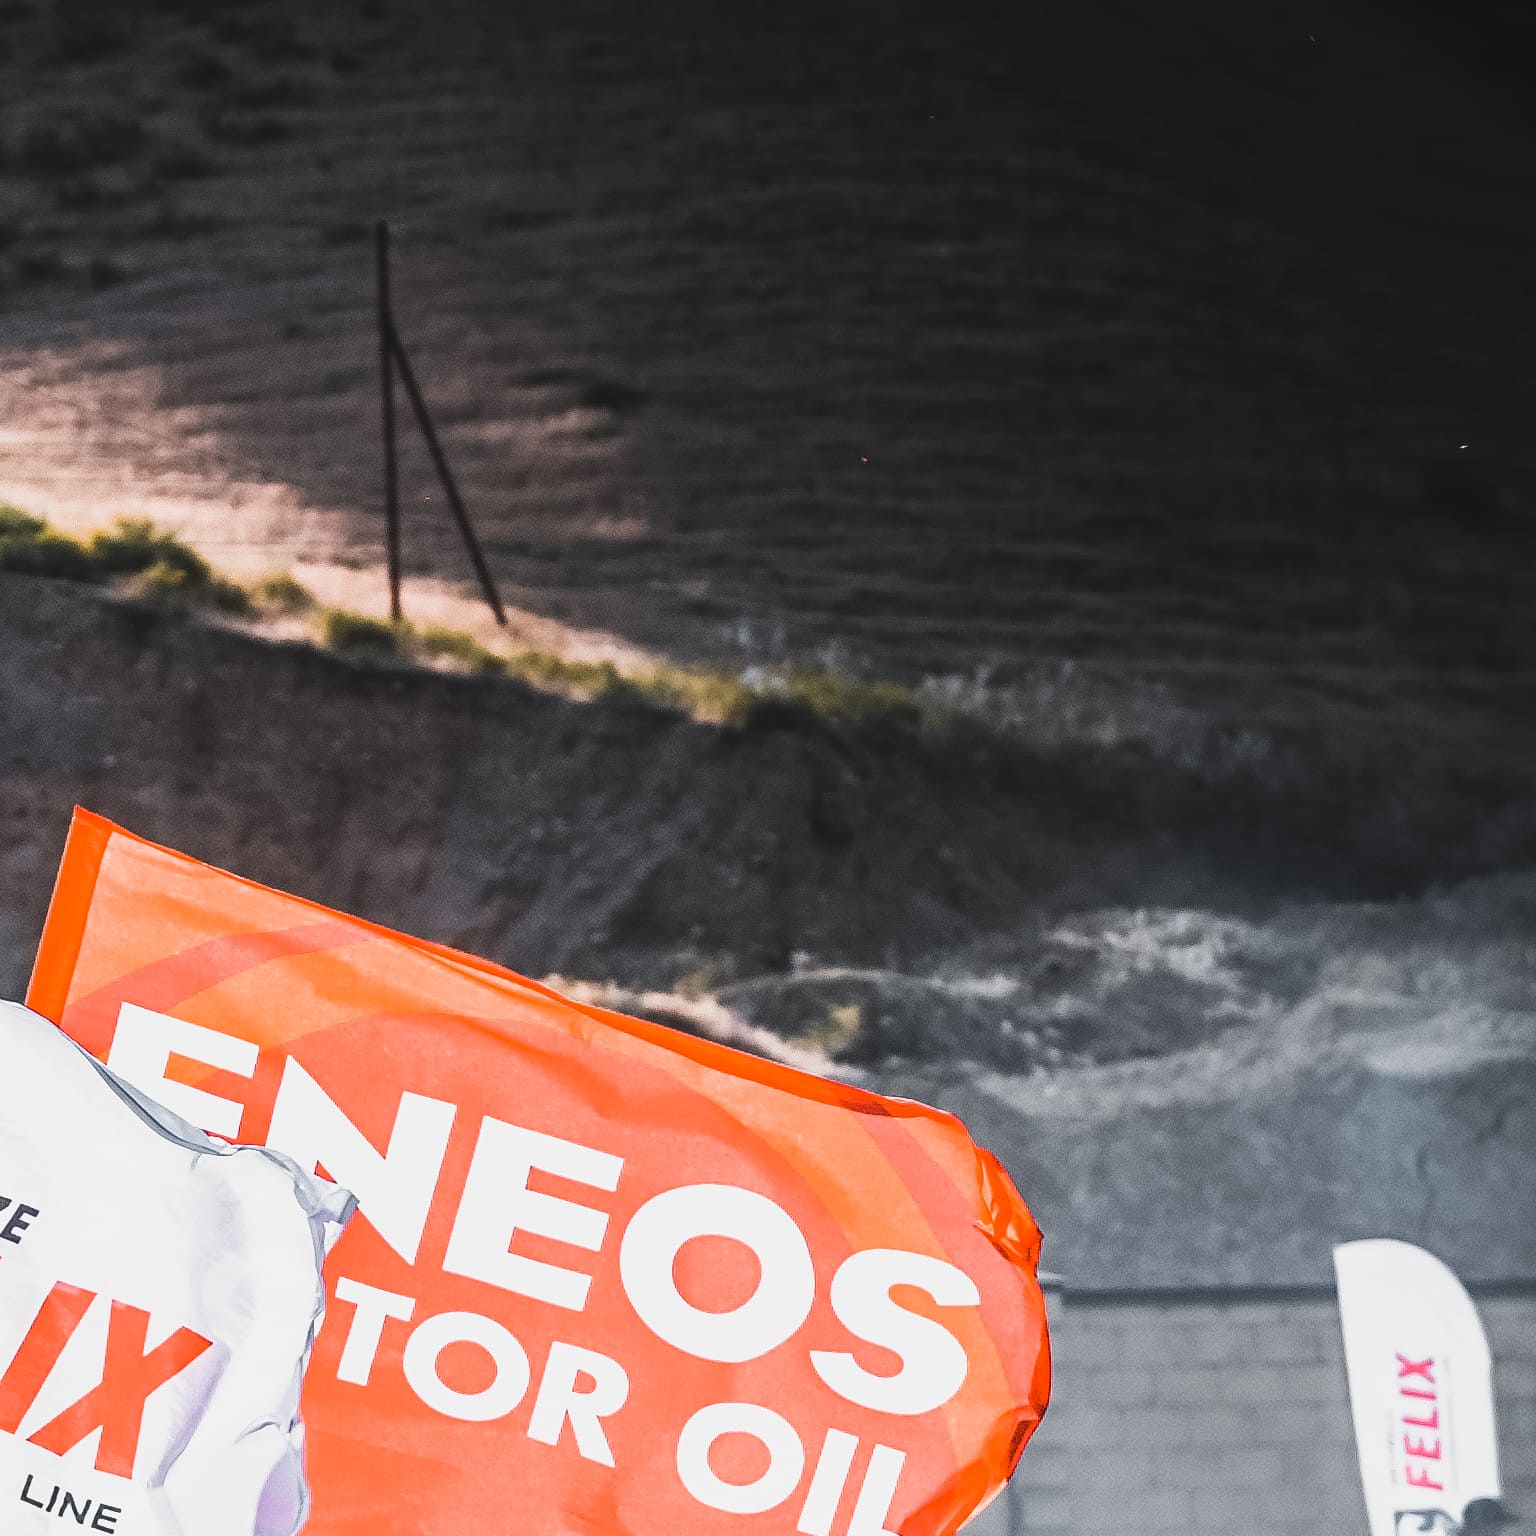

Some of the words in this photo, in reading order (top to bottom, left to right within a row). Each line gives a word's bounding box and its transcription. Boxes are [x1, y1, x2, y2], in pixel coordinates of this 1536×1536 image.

[106, 1002, 981, 1416] ENEOS
[334, 1276, 630, 1468] TOR
[1395, 1352, 1444, 1491] FELIX
[19, 1474, 123, 1535] LINE
